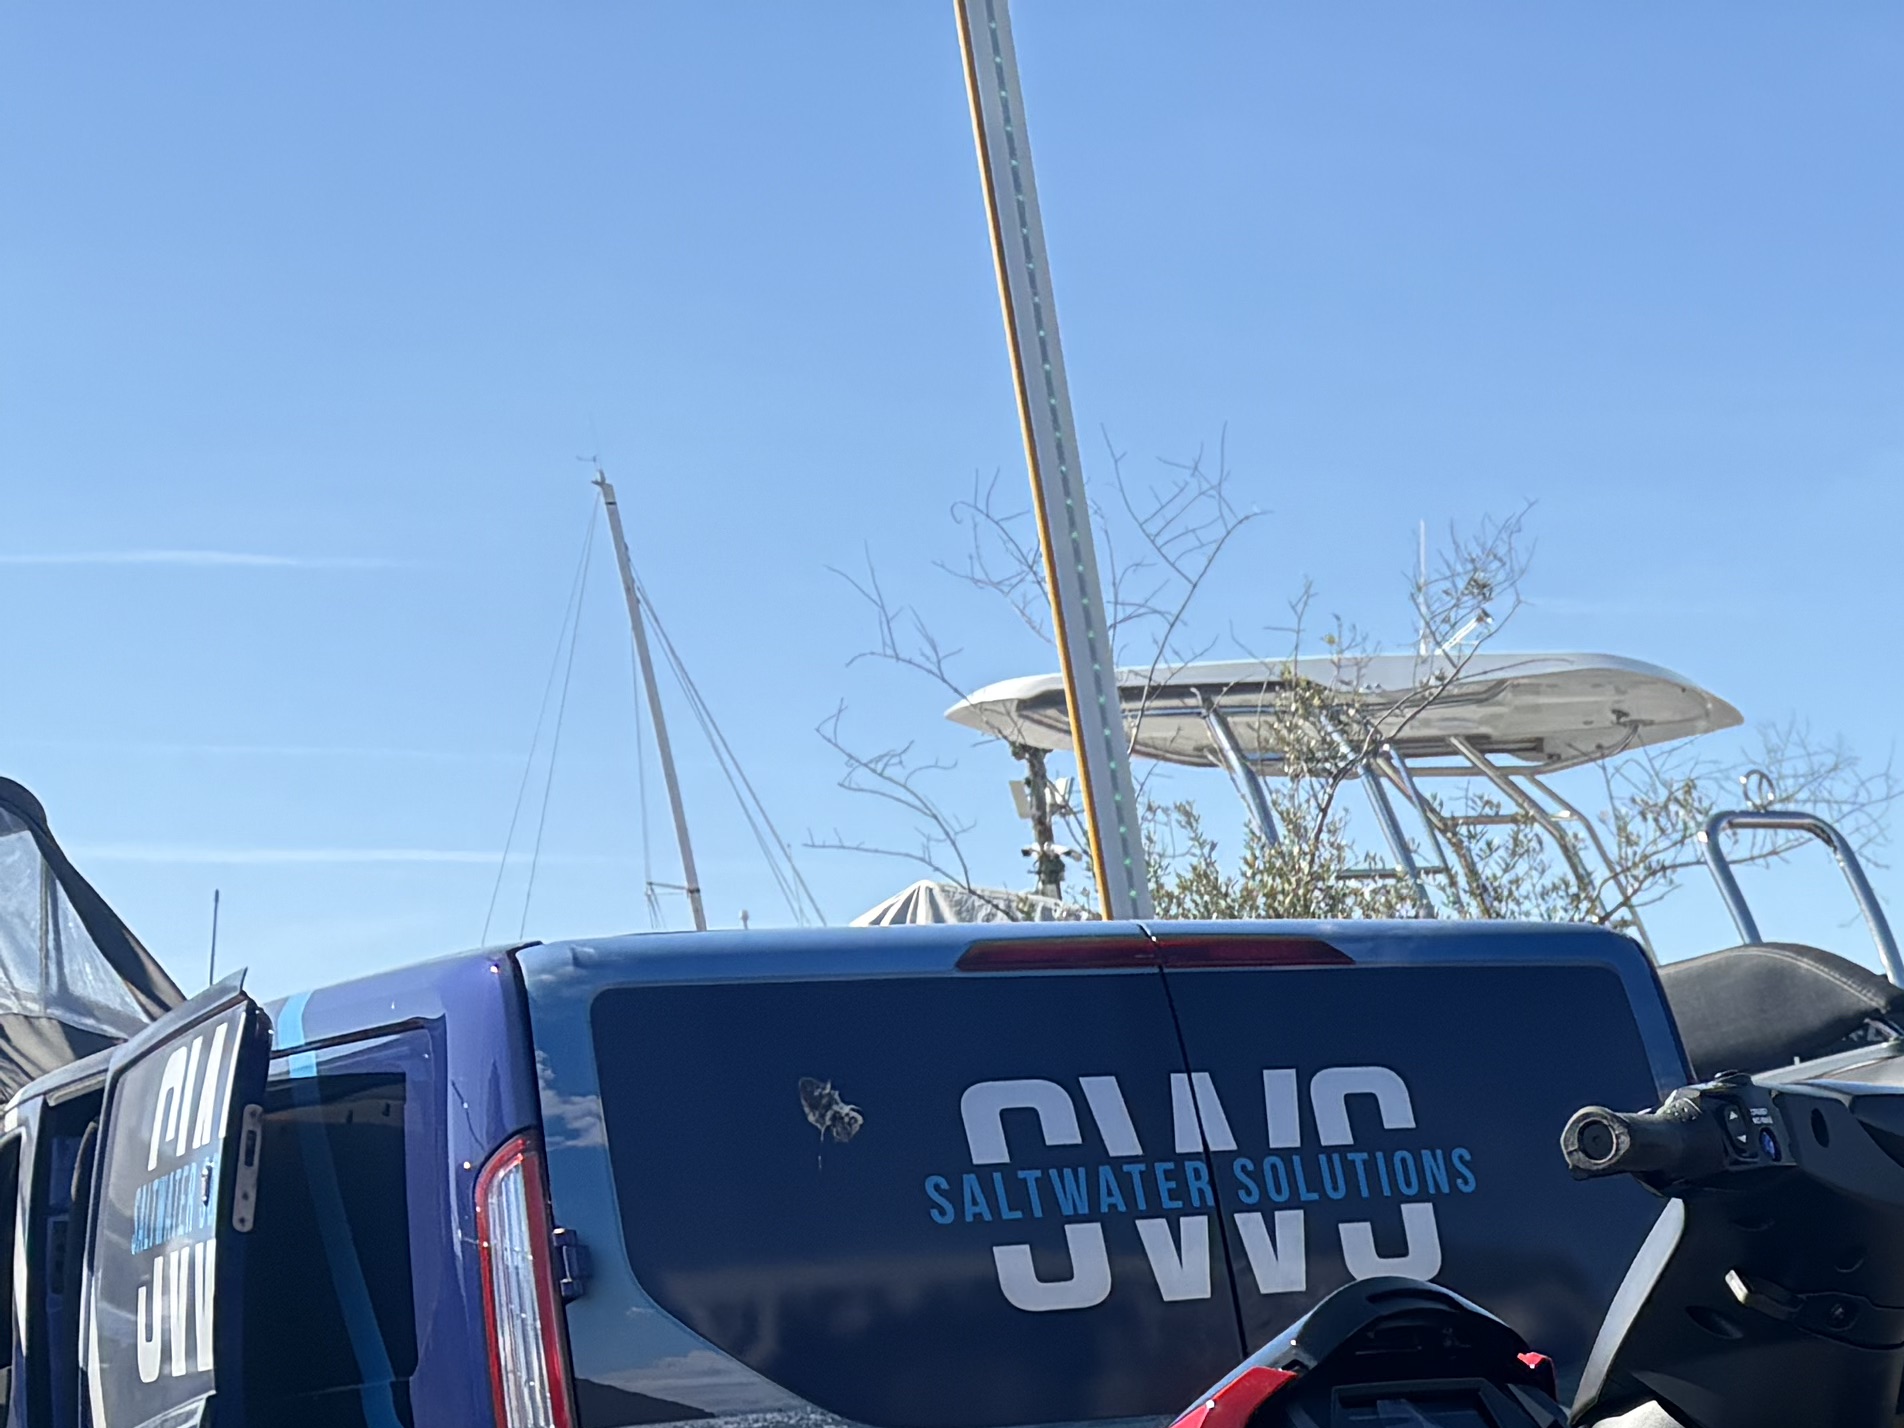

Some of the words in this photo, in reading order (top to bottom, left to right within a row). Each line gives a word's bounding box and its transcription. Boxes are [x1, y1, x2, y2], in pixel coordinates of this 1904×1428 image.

[924, 1159, 1216, 1225] SALTWATER
[1235, 1146, 1477, 1204] SOLUTIONS
[959, 1066, 1443, 1312] SWS
